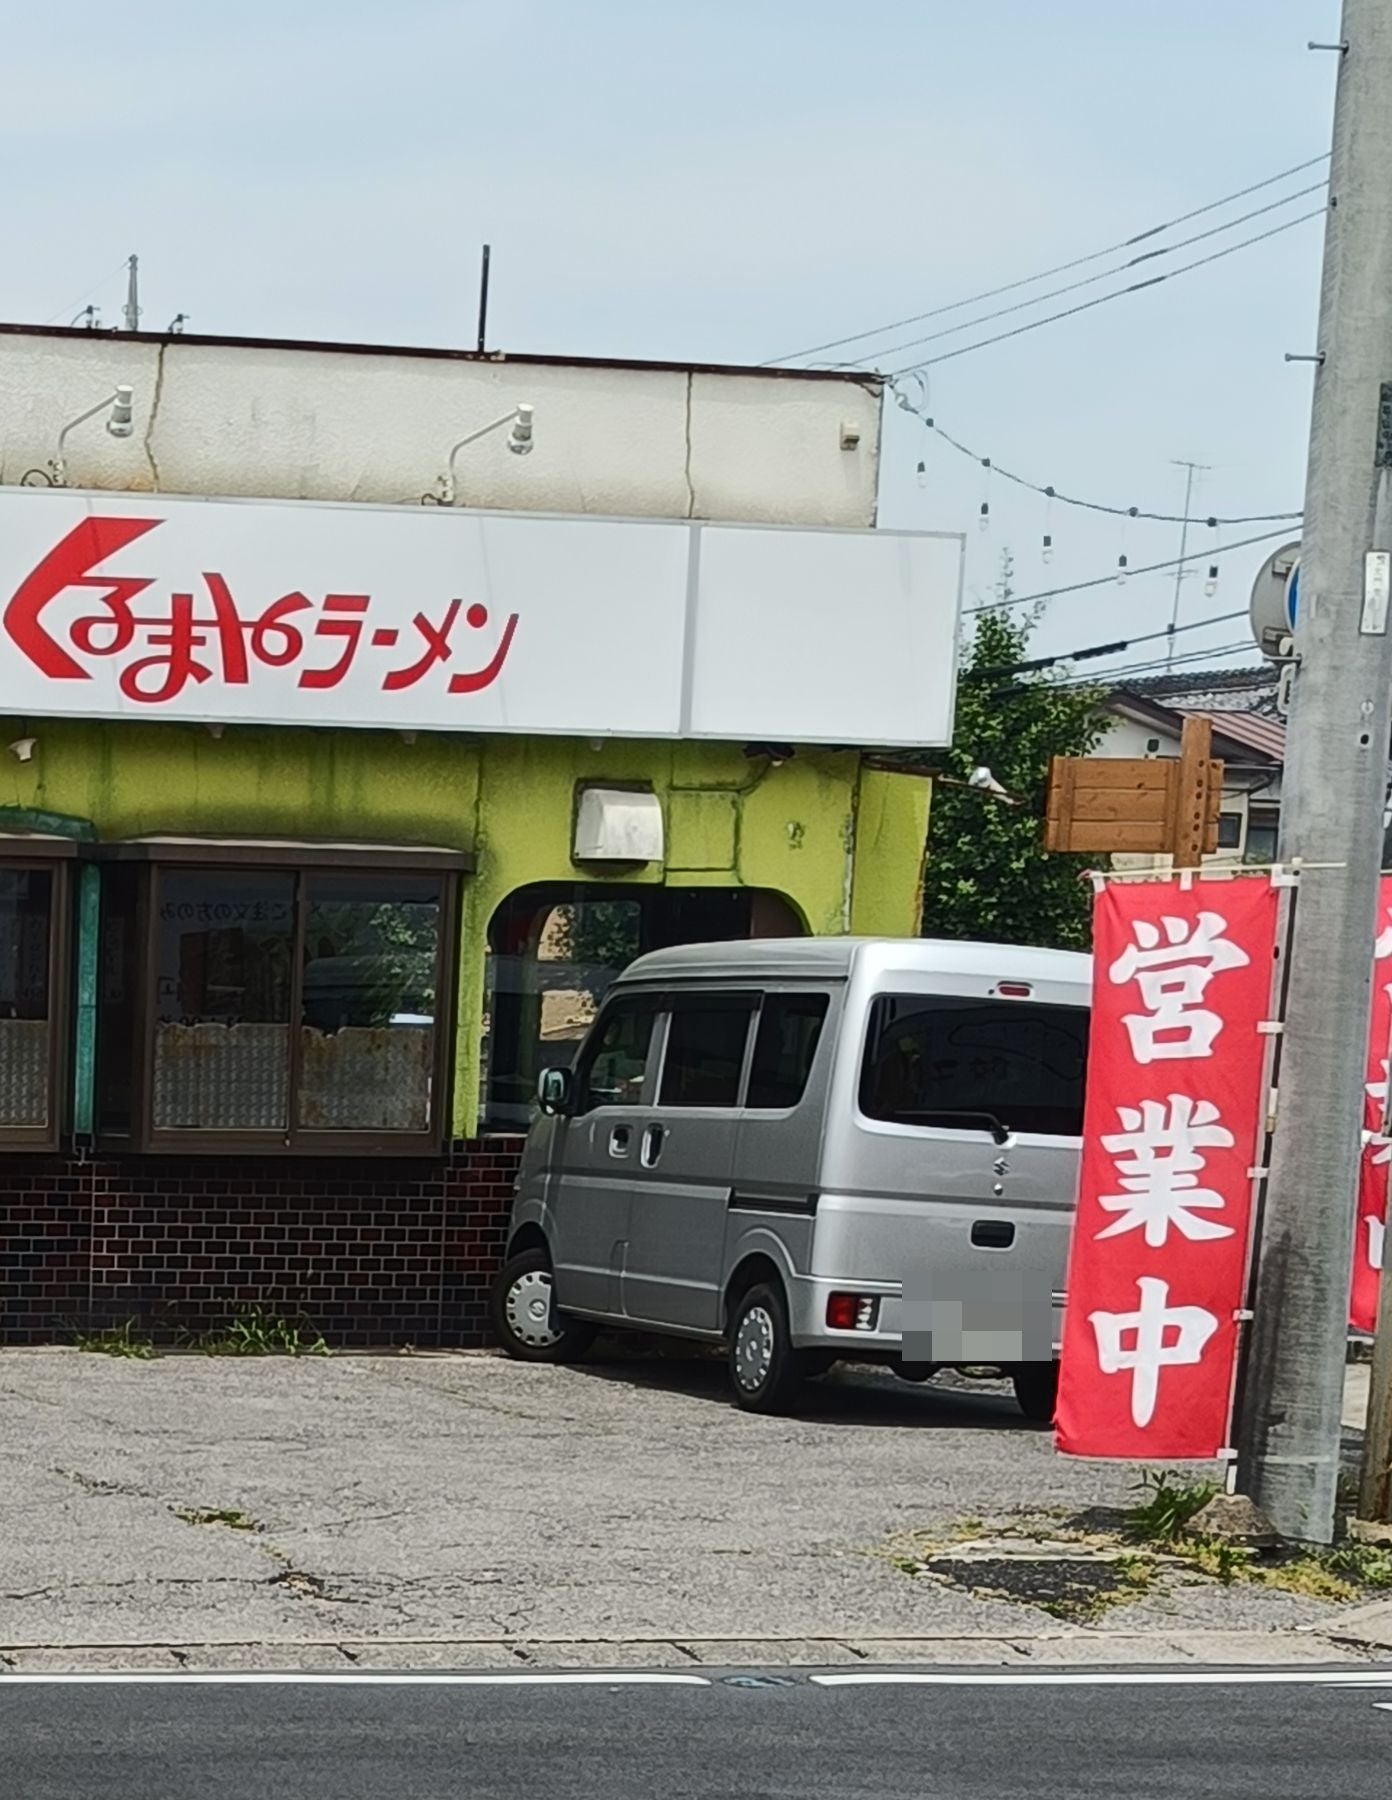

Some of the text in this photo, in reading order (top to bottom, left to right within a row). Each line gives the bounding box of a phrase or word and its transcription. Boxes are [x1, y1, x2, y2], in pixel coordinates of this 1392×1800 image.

[3, 516, 520, 702] くるまやラーメン
[1087, 910, 1251, 1428] 営業中
